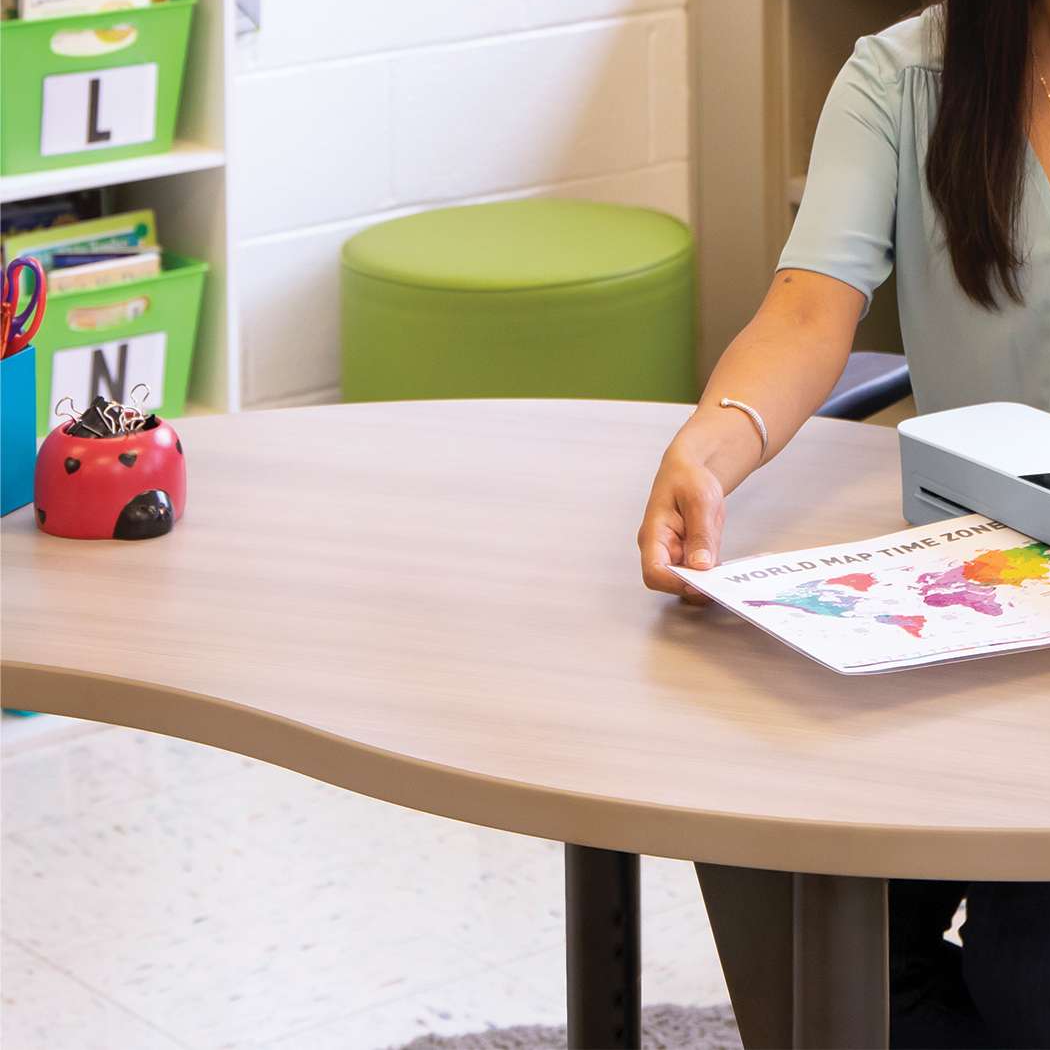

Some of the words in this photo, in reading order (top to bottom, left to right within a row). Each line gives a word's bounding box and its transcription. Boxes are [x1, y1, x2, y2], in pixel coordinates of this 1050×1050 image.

[87, 77, 112, 144] L
[90, 344, 128, 412] N
[725, 560, 817, 584] WORLD
[819, 551, 874, 568] MAP
[876, 537, 940, 556] TIME
